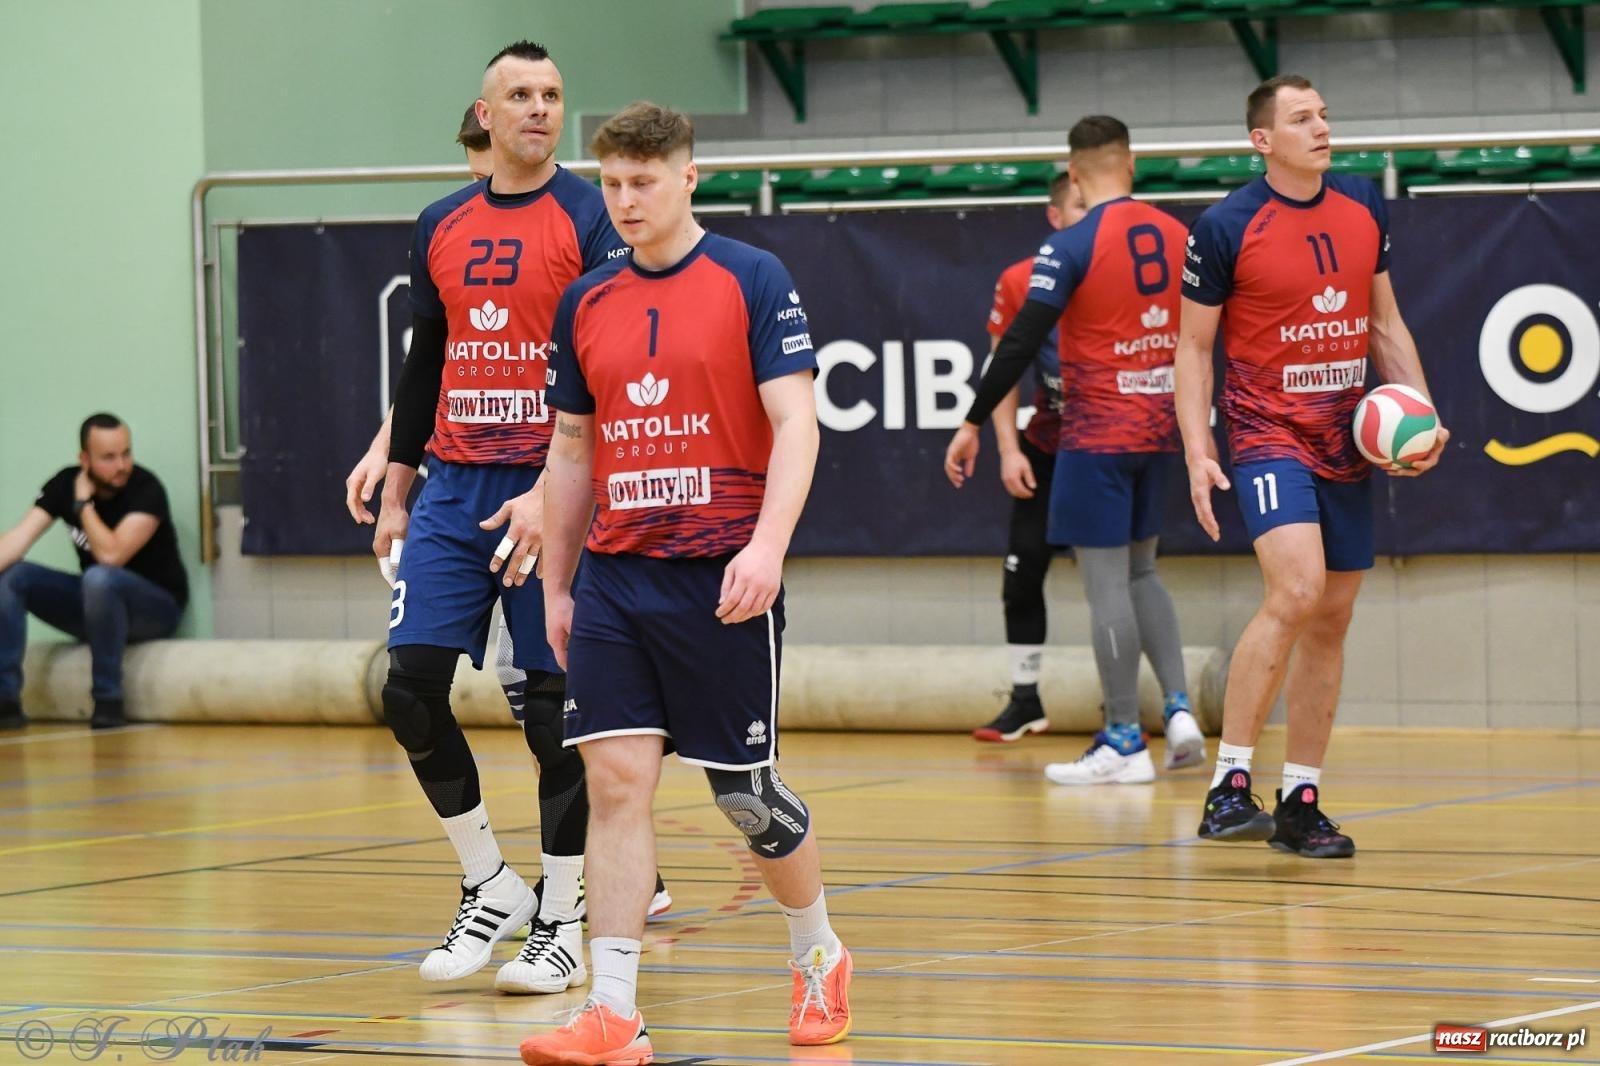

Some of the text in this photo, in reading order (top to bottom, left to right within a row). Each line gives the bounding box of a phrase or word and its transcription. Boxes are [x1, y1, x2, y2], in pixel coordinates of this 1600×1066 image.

[464, 238, 523, 286] 23
[608, 247, 632, 259] KAT
[1127, 223, 1170, 296] 8
[1306, 232, 1339, 275] 11
[646, 308, 659, 357] 1
[1280, 316, 1368, 342] KATOLIK
[448, 341, 549, 361] KATOLIK
[1302, 340, 1358, 354] GROUP
[457, 366, 525, 377] GROUP
[814, 340, 994, 430] CIB
[601, 414, 711, 443] KATOLIK
[616, 442, 688, 459] GROUP
[1253, 472, 1280, 515] 11
